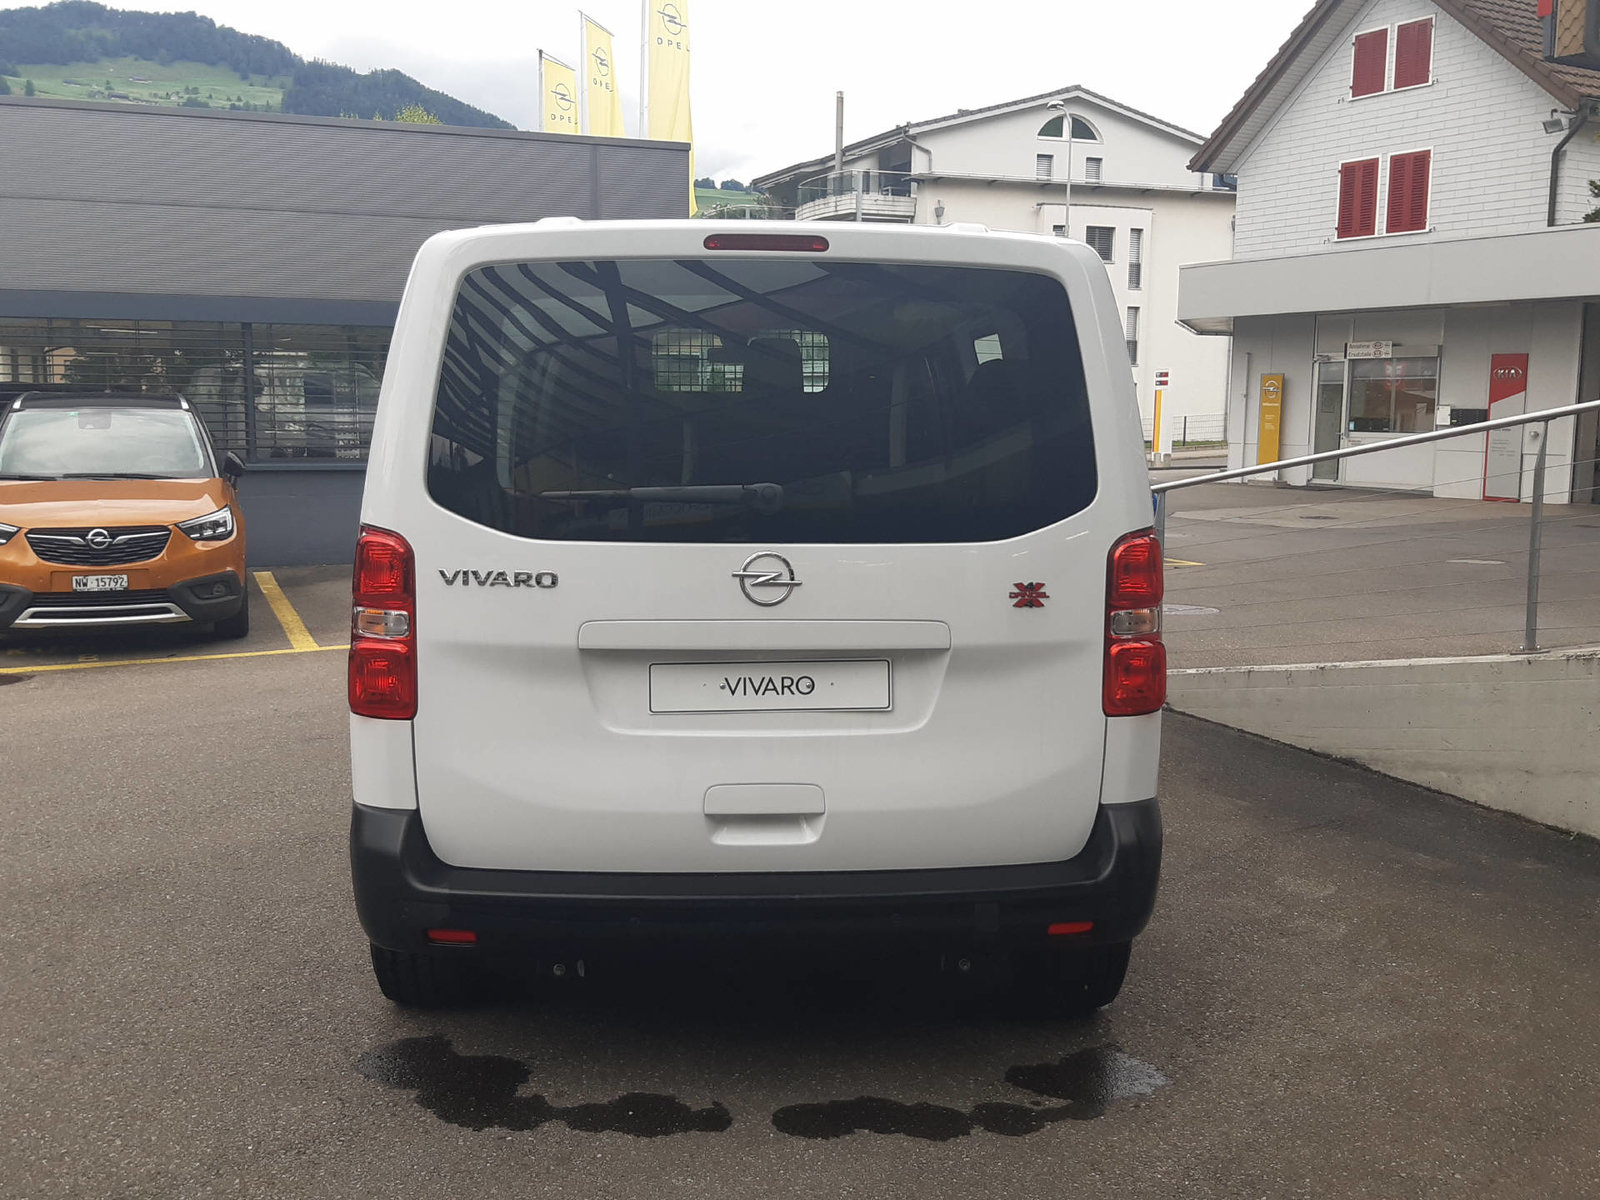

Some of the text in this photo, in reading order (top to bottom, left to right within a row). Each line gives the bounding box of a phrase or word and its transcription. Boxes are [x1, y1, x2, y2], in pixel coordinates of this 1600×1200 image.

[550, 113, 578, 125] OPE
[75, 576, 125, 588] NW 15792
[438, 568, 559, 588] VIVARO
[724, 676, 815, 696] VIVARO
